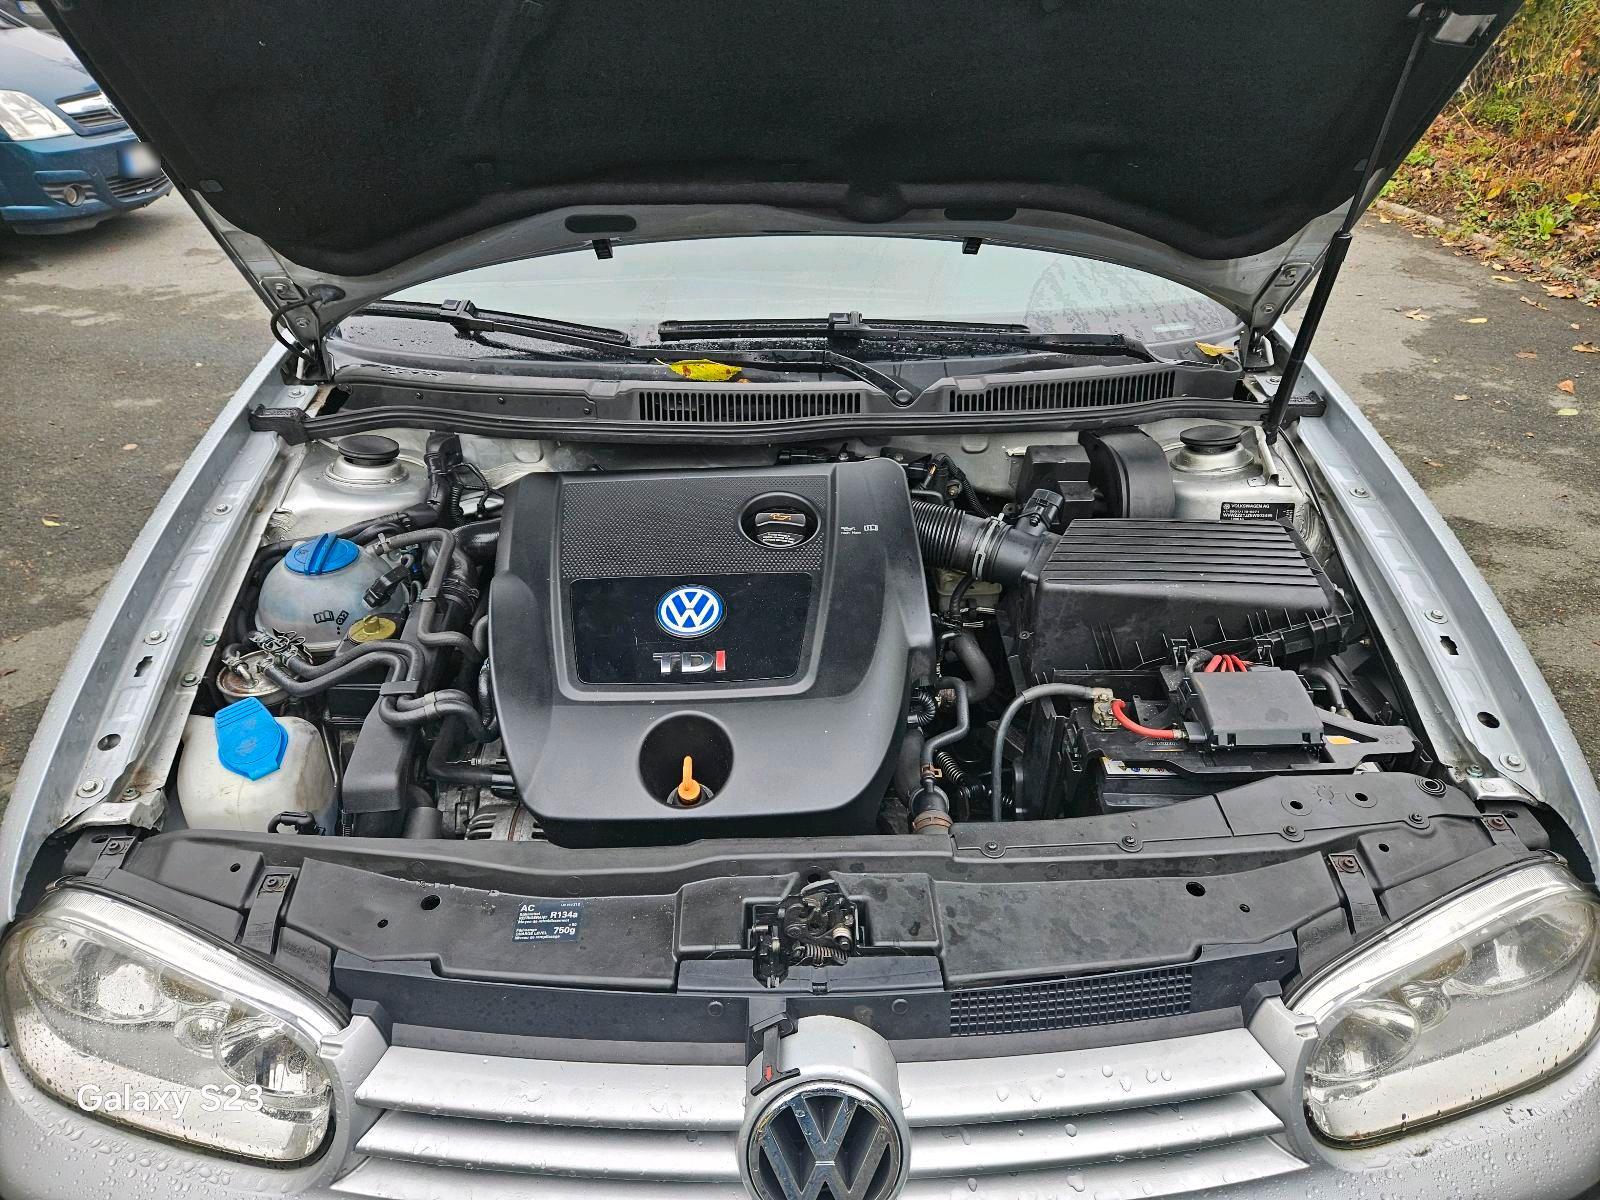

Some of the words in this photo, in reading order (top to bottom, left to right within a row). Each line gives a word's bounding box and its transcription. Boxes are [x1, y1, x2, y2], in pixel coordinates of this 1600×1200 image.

[659, 587, 722, 635] VW
[653, 650, 726, 673] TDI
[520, 904, 535, 912] AC
[550, 911, 578, 919] R134a
[553, 927, 576, 935] 750g
[750, 1082, 903, 1200] VW
